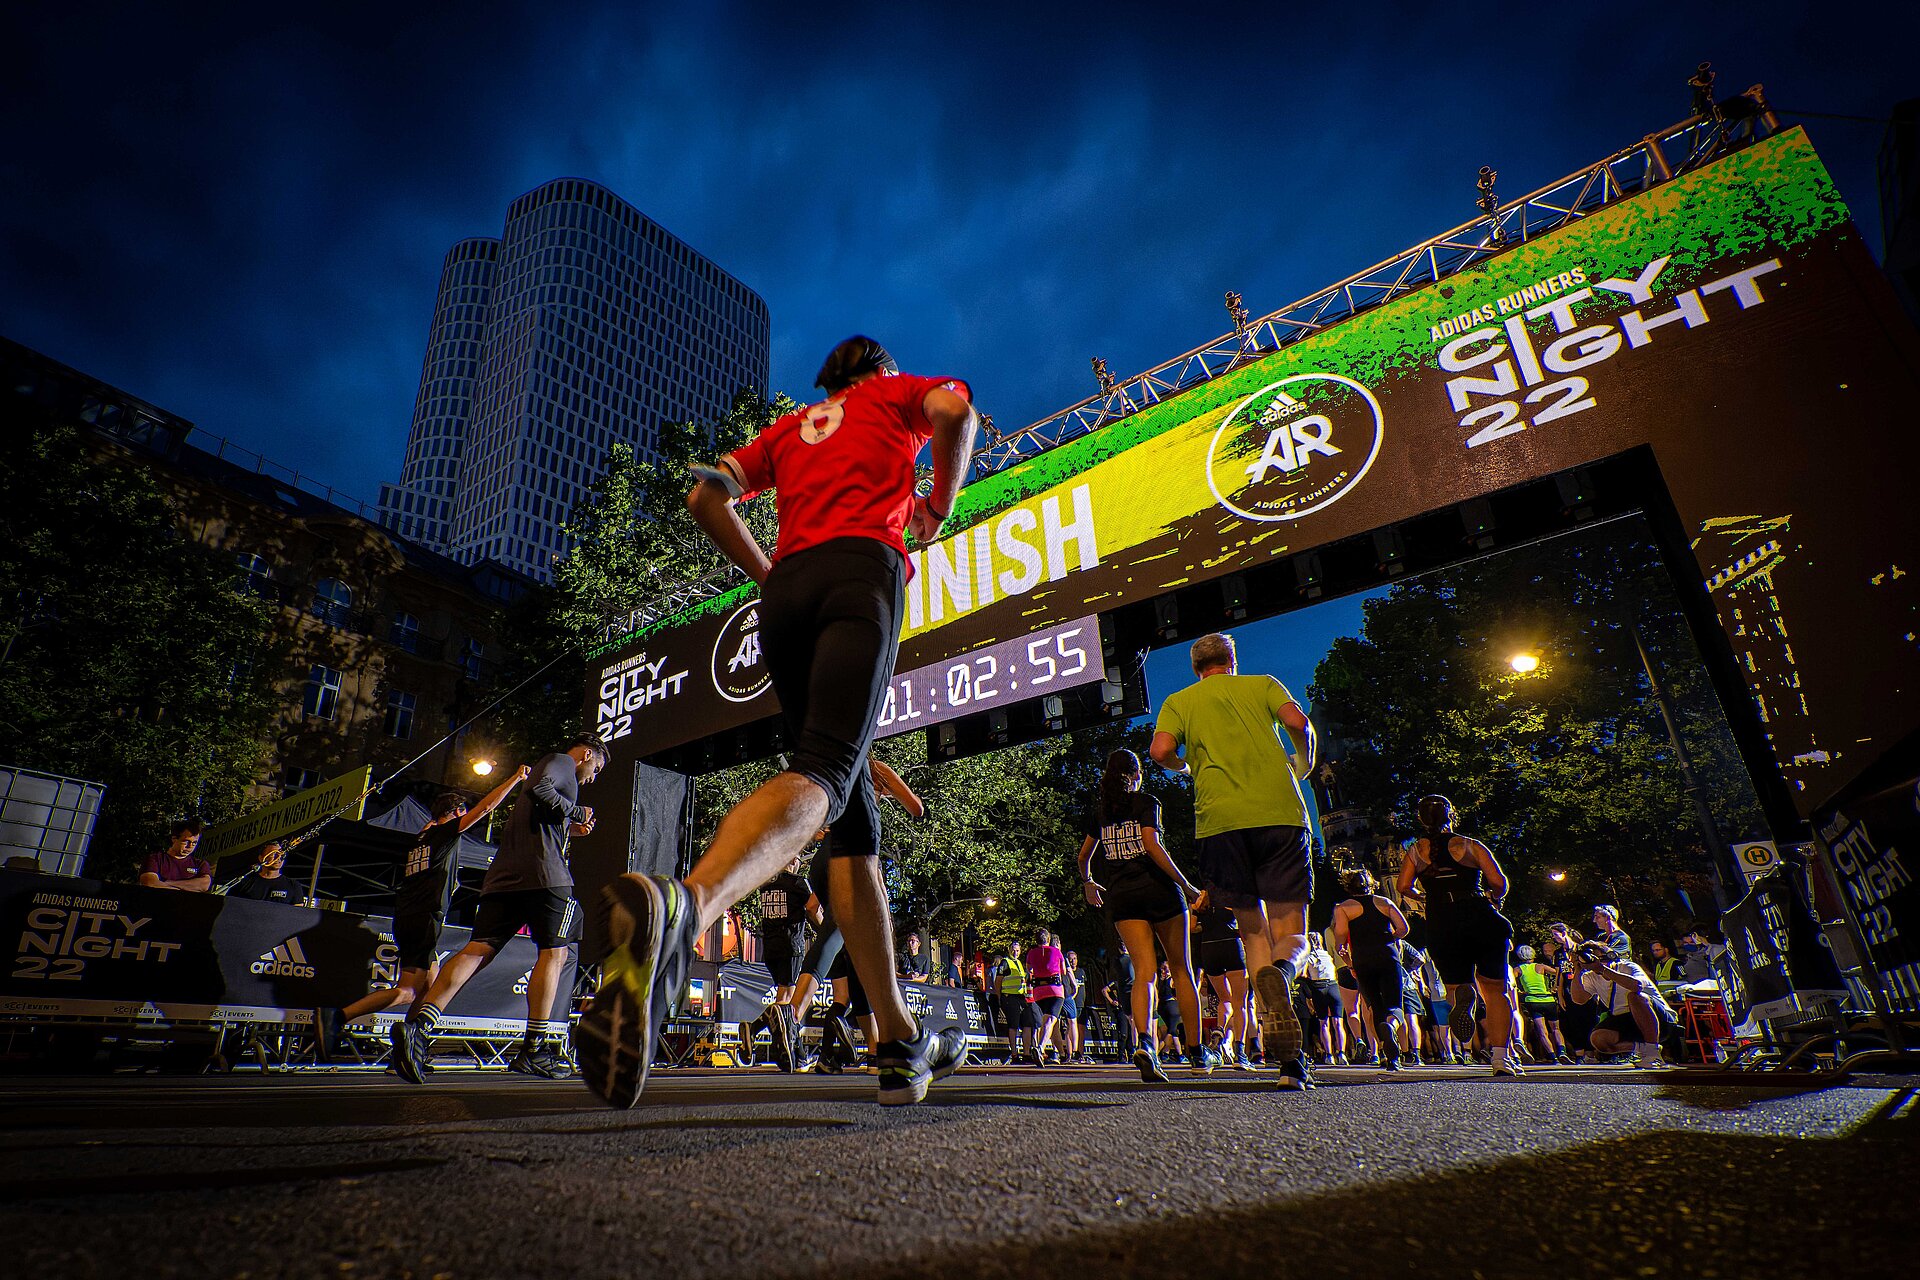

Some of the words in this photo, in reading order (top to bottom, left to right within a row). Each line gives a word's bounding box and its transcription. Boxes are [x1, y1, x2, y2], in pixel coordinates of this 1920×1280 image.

[1430, 303, 1496, 342] ADIDAS
[1496, 266, 1587, 316] RUNNERS
[1438, 254, 1672, 384] CITY
[1445, 258, 1783, 413] NIGHT
[1258, 400, 1308, 426] adidas
[1458, 376, 1597, 449] 22
[1244, 414, 1343, 485] AR
[1254, 499, 1296, 510] ADIDAS
[1299, 470, 1348, 504] RUNNERS
[907, 483, 1100, 630] INISH
[600, 661, 621, 680] ADIDAS
[621, 651, 647, 671] RUNNERS
[600, 655, 668, 706] CITY
[597, 670, 689, 724] NIGHT
[596, 714, 632, 743] 22
[258, 811, 282, 837] CITY
[282, 797, 315, 829] NIGHT
[314, 785, 343, 816] 2022
[1750, 850, 1766, 863] H
[32, 892, 72, 907] ADIDAS
[73, 898, 119, 911] RUNNERS
[27, 907, 153, 946] CITY
[17, 931, 182, 963] NIGHT
[11, 956, 86, 981] 22
[250, 960, 315, 979] adidas
